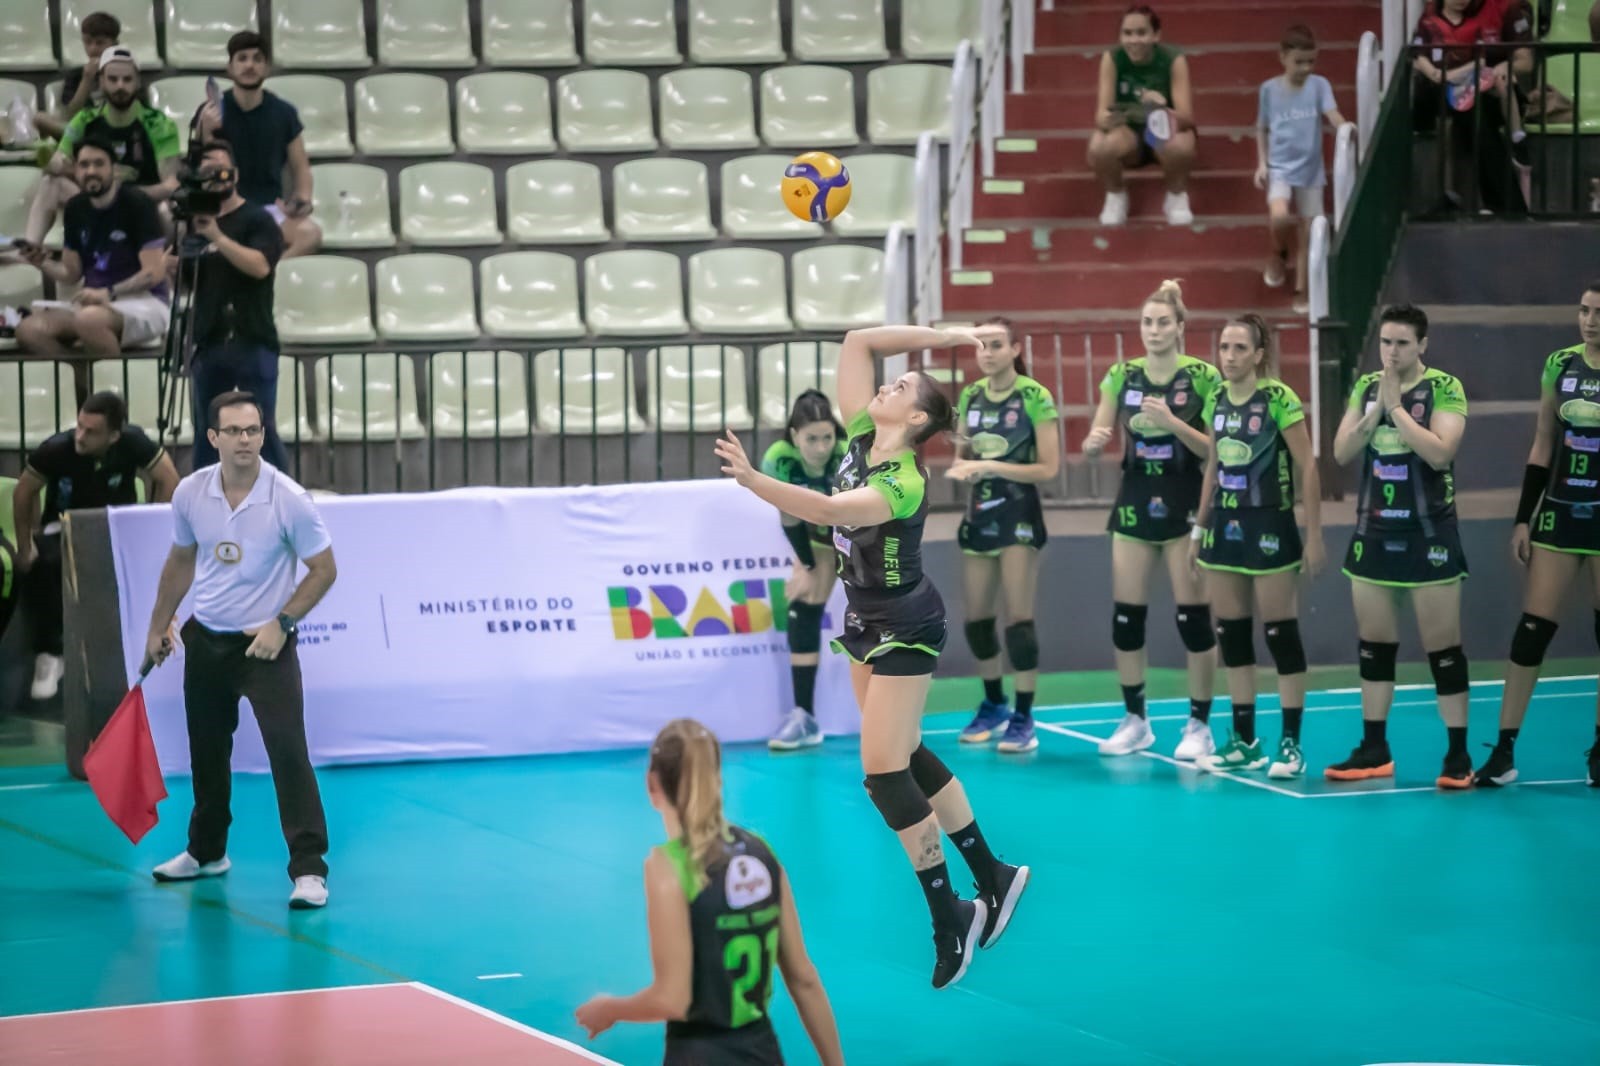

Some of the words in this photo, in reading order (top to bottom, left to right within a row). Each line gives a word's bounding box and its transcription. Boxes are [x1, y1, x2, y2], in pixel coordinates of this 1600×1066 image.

[1570, 453, 1589, 475] 13
[1221, 491, 1239, 509] 14
[1383, 483, 1396, 506] 9
[1118, 505, 1138, 527] 15
[1538, 511, 1556, 532] 13
[1353, 541, 1364, 562] 9
[622, 560, 714, 576] GOVERNO
[722, 556, 794, 570] FEDERA
[419, 596, 538, 615] MINISTÉRIO
[546, 597, 574, 611] DO
[607, 577, 833, 641] BRASI
[486, 618, 577, 633] ESPORTE
[635, 646, 683, 661] UNIÃO
[689, 647, 696, 659] E
[703, 642, 791, 659] RECONSTRU
